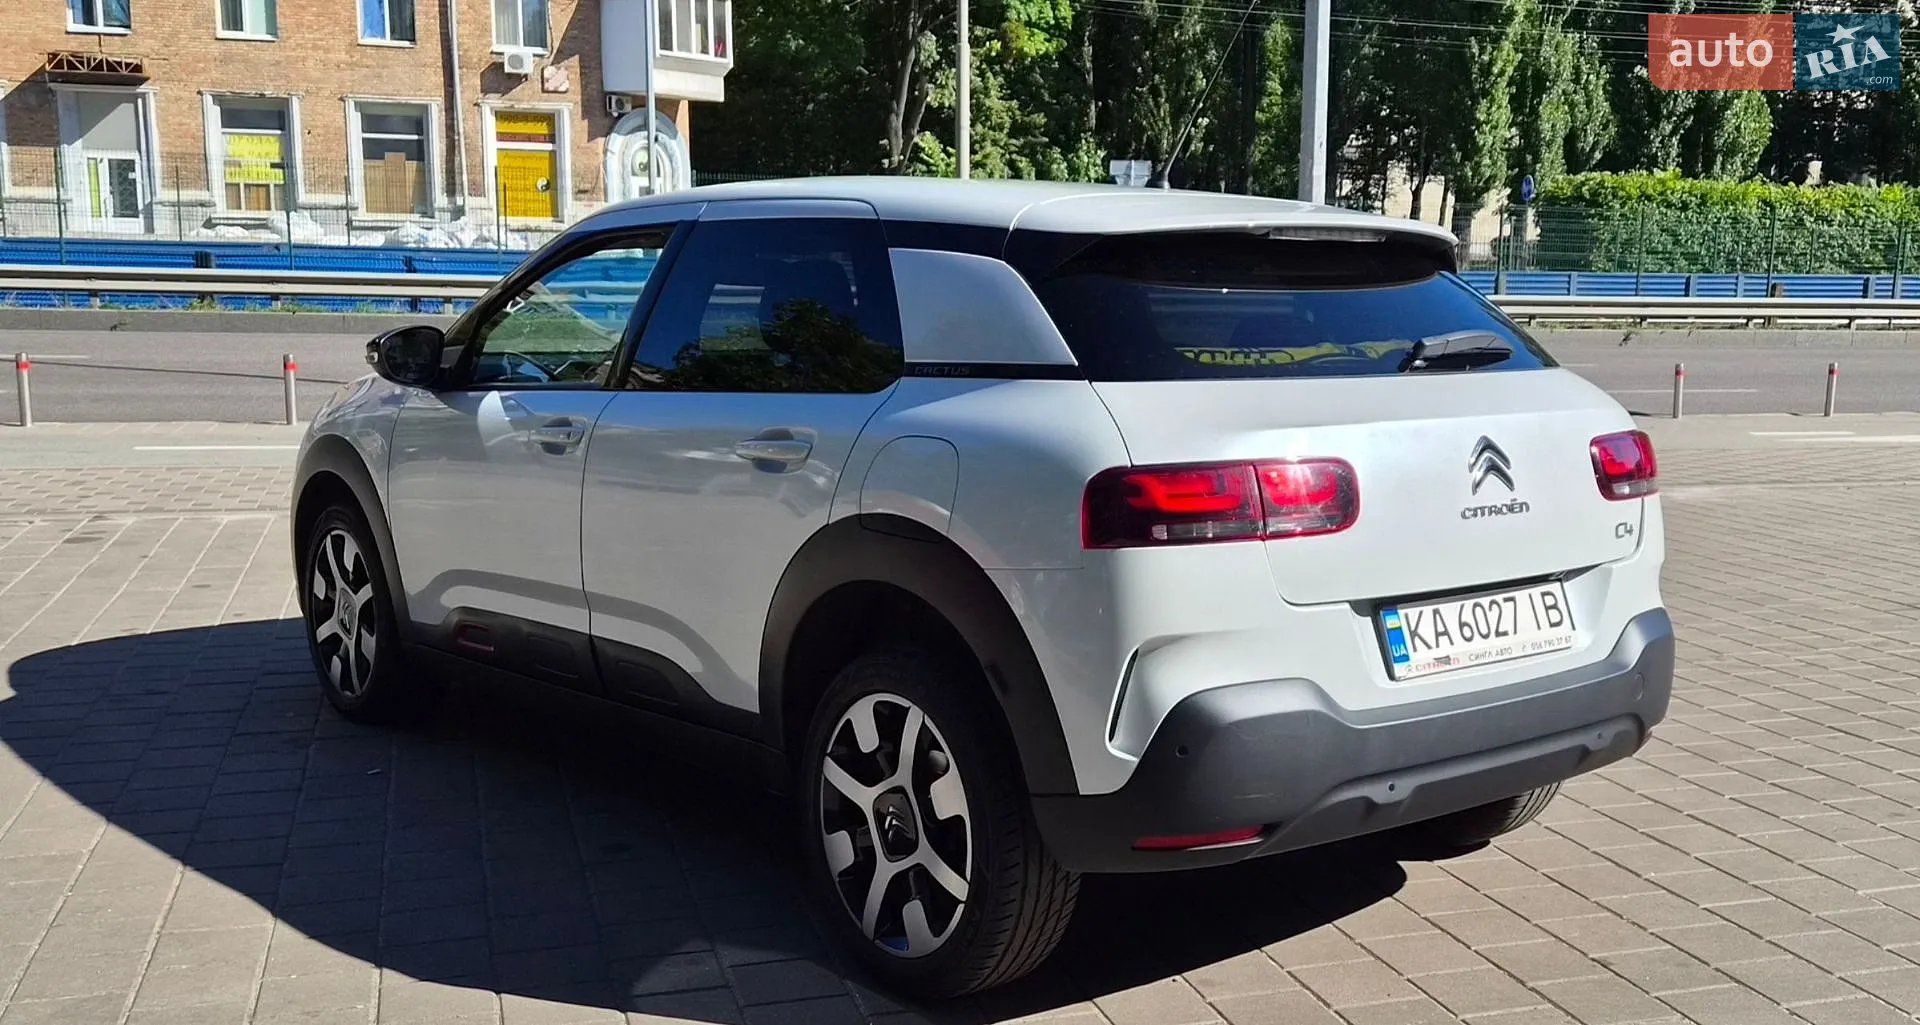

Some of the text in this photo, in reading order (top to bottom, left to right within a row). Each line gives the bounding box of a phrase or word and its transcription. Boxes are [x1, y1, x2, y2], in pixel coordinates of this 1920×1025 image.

[914, 366, 970, 376] CACTUS
[1614, 522, 1634, 540] C4
[1405, 590, 1564, 652] KA 6027 IB
[1392, 643, 1409, 657] UA
[1495, 646, 1513, 657] АВТО
